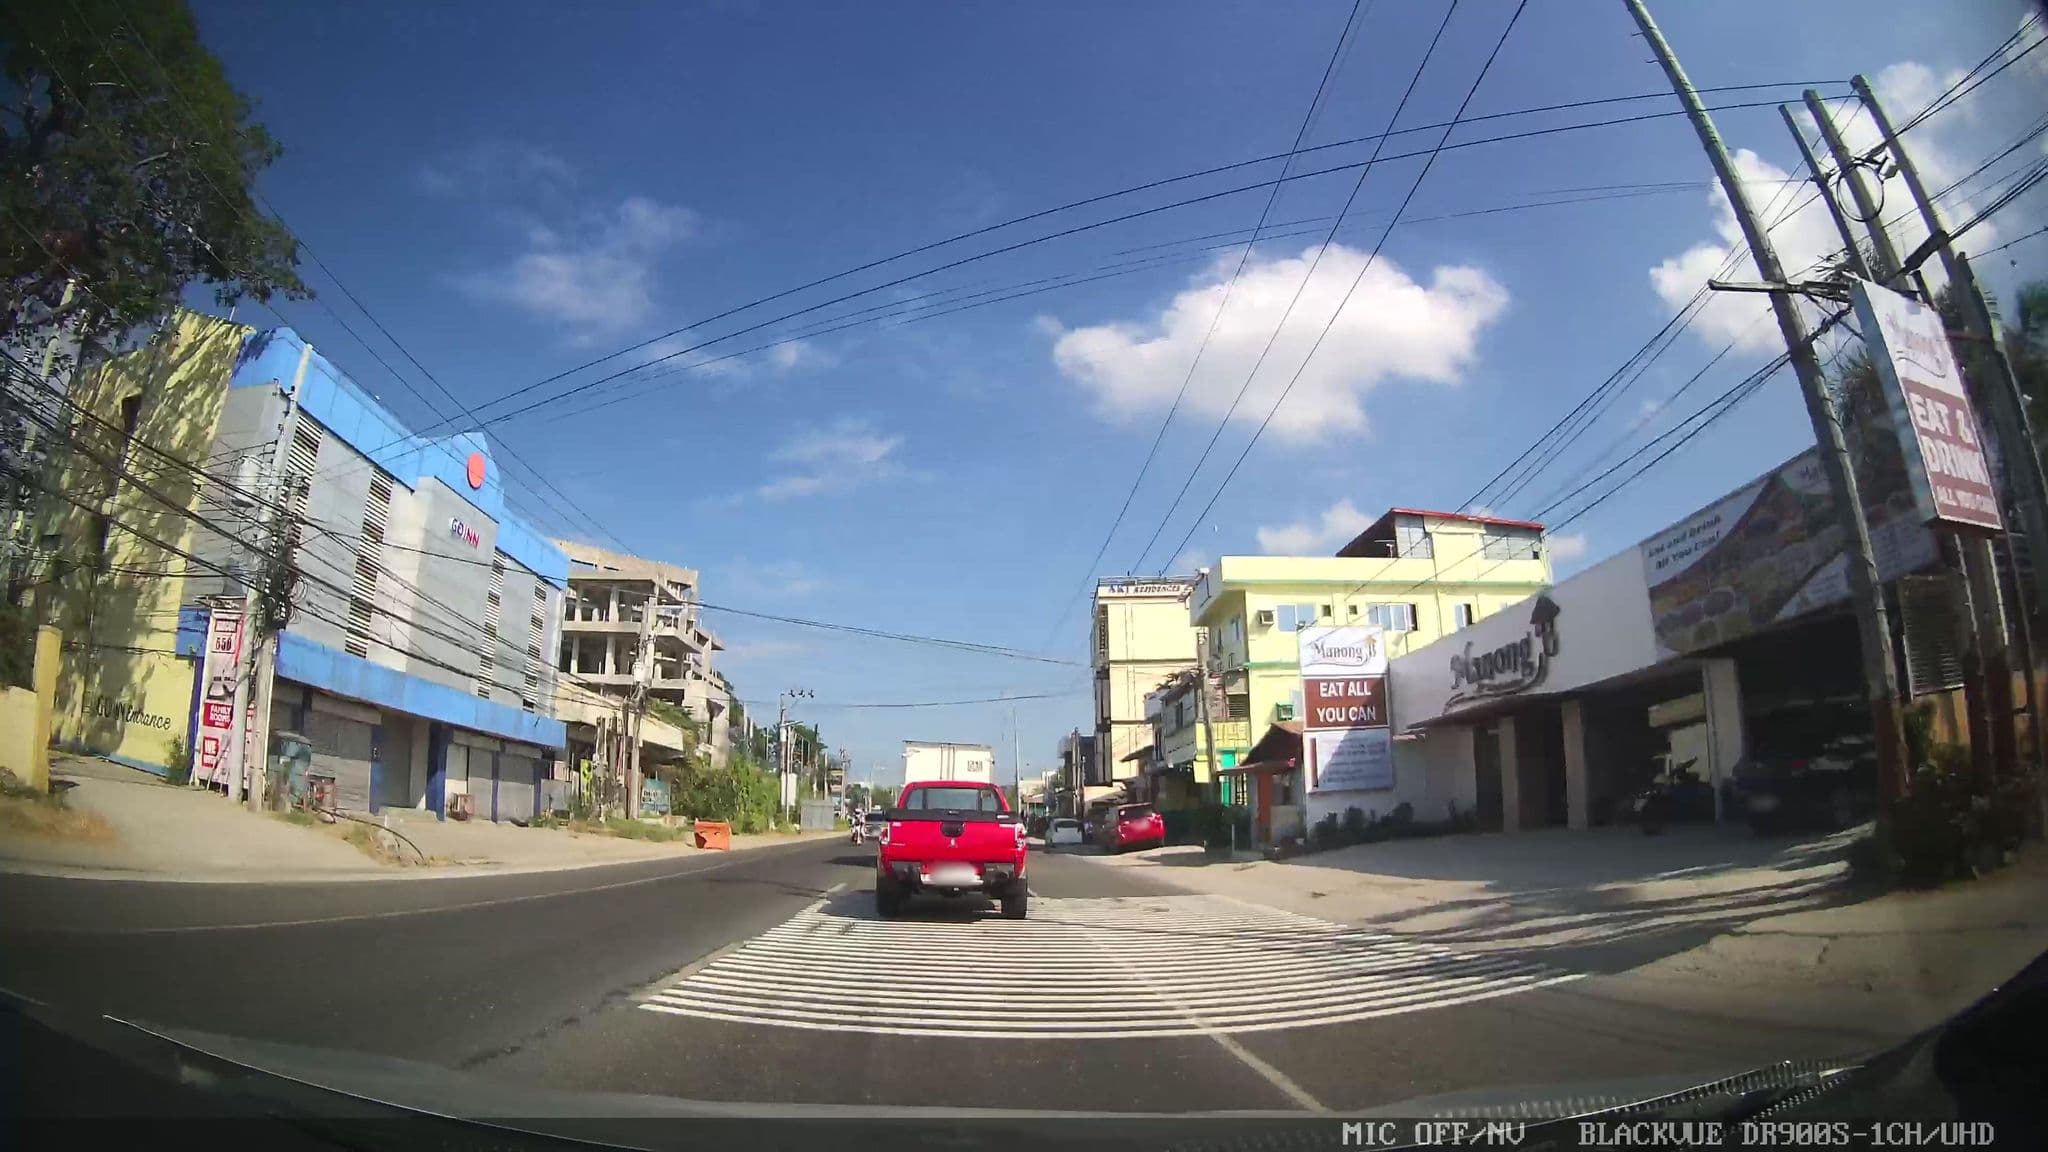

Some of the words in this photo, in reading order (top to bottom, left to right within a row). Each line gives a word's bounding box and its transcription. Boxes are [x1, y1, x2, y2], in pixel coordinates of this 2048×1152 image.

[1909, 392, 1952, 436] EAT
[1919, 435, 1991, 487] DRINK
[1314, 641, 1363, 661] Manong
[1448, 631, 1535, 690] Manong
[1319, 682, 1345, 698] EAT
[1347, 681, 1372, 696] ALL
[126, 704, 171, 730] Entrance
[1316, 707, 1346, 722] YOU
[1348, 706, 1376, 721] CAN
